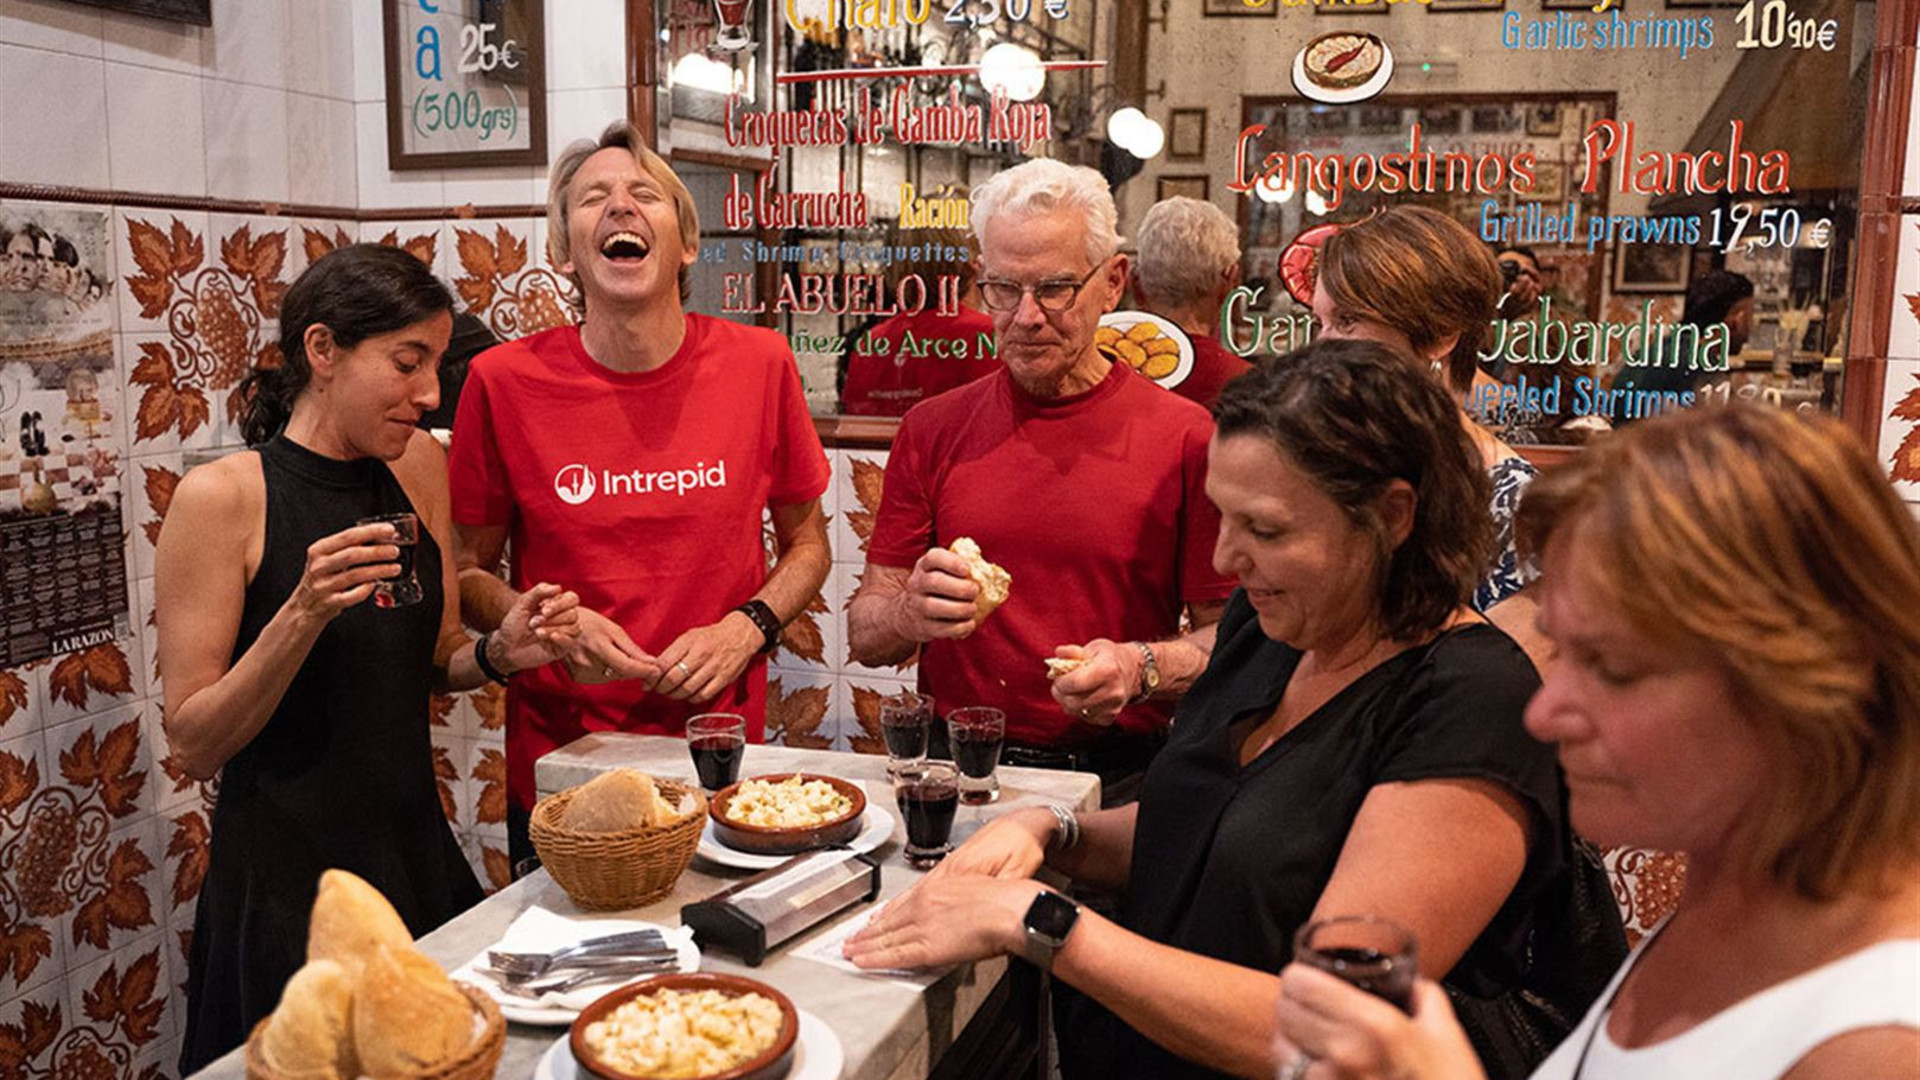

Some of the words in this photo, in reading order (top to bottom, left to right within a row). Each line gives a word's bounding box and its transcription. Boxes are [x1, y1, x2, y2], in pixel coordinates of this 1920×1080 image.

[458, 23, 519, 73] 25€
[1501, 10, 1587, 49] Garlic
[1592, 9, 1714, 59] shrimps
[413, 83, 517, 141] (500grs)
[724, 92, 847, 160] Croquetas
[854, 85, 885, 146] de
[891, 77, 983, 146] Gamba
[988, 84, 1052, 154] Roja
[1226, 121, 1537, 211] Langostinos
[1580, 118, 1792, 196] Plancha
[723, 172, 753, 231] de
[755, 160, 870, 230] Garrucha
[899, 183, 969, 230] Ración
[1480, 200, 1576, 243] Grilled
[1588, 209, 1701, 253] prawns
[722, 272, 766, 314] EL
[772, 271, 927, 318] ABUELO
[935, 274, 961, 318] II
[854, 331, 890, 357] de
[899, 329, 968, 360] Arce
[602, 459, 727, 496] Intrepid
